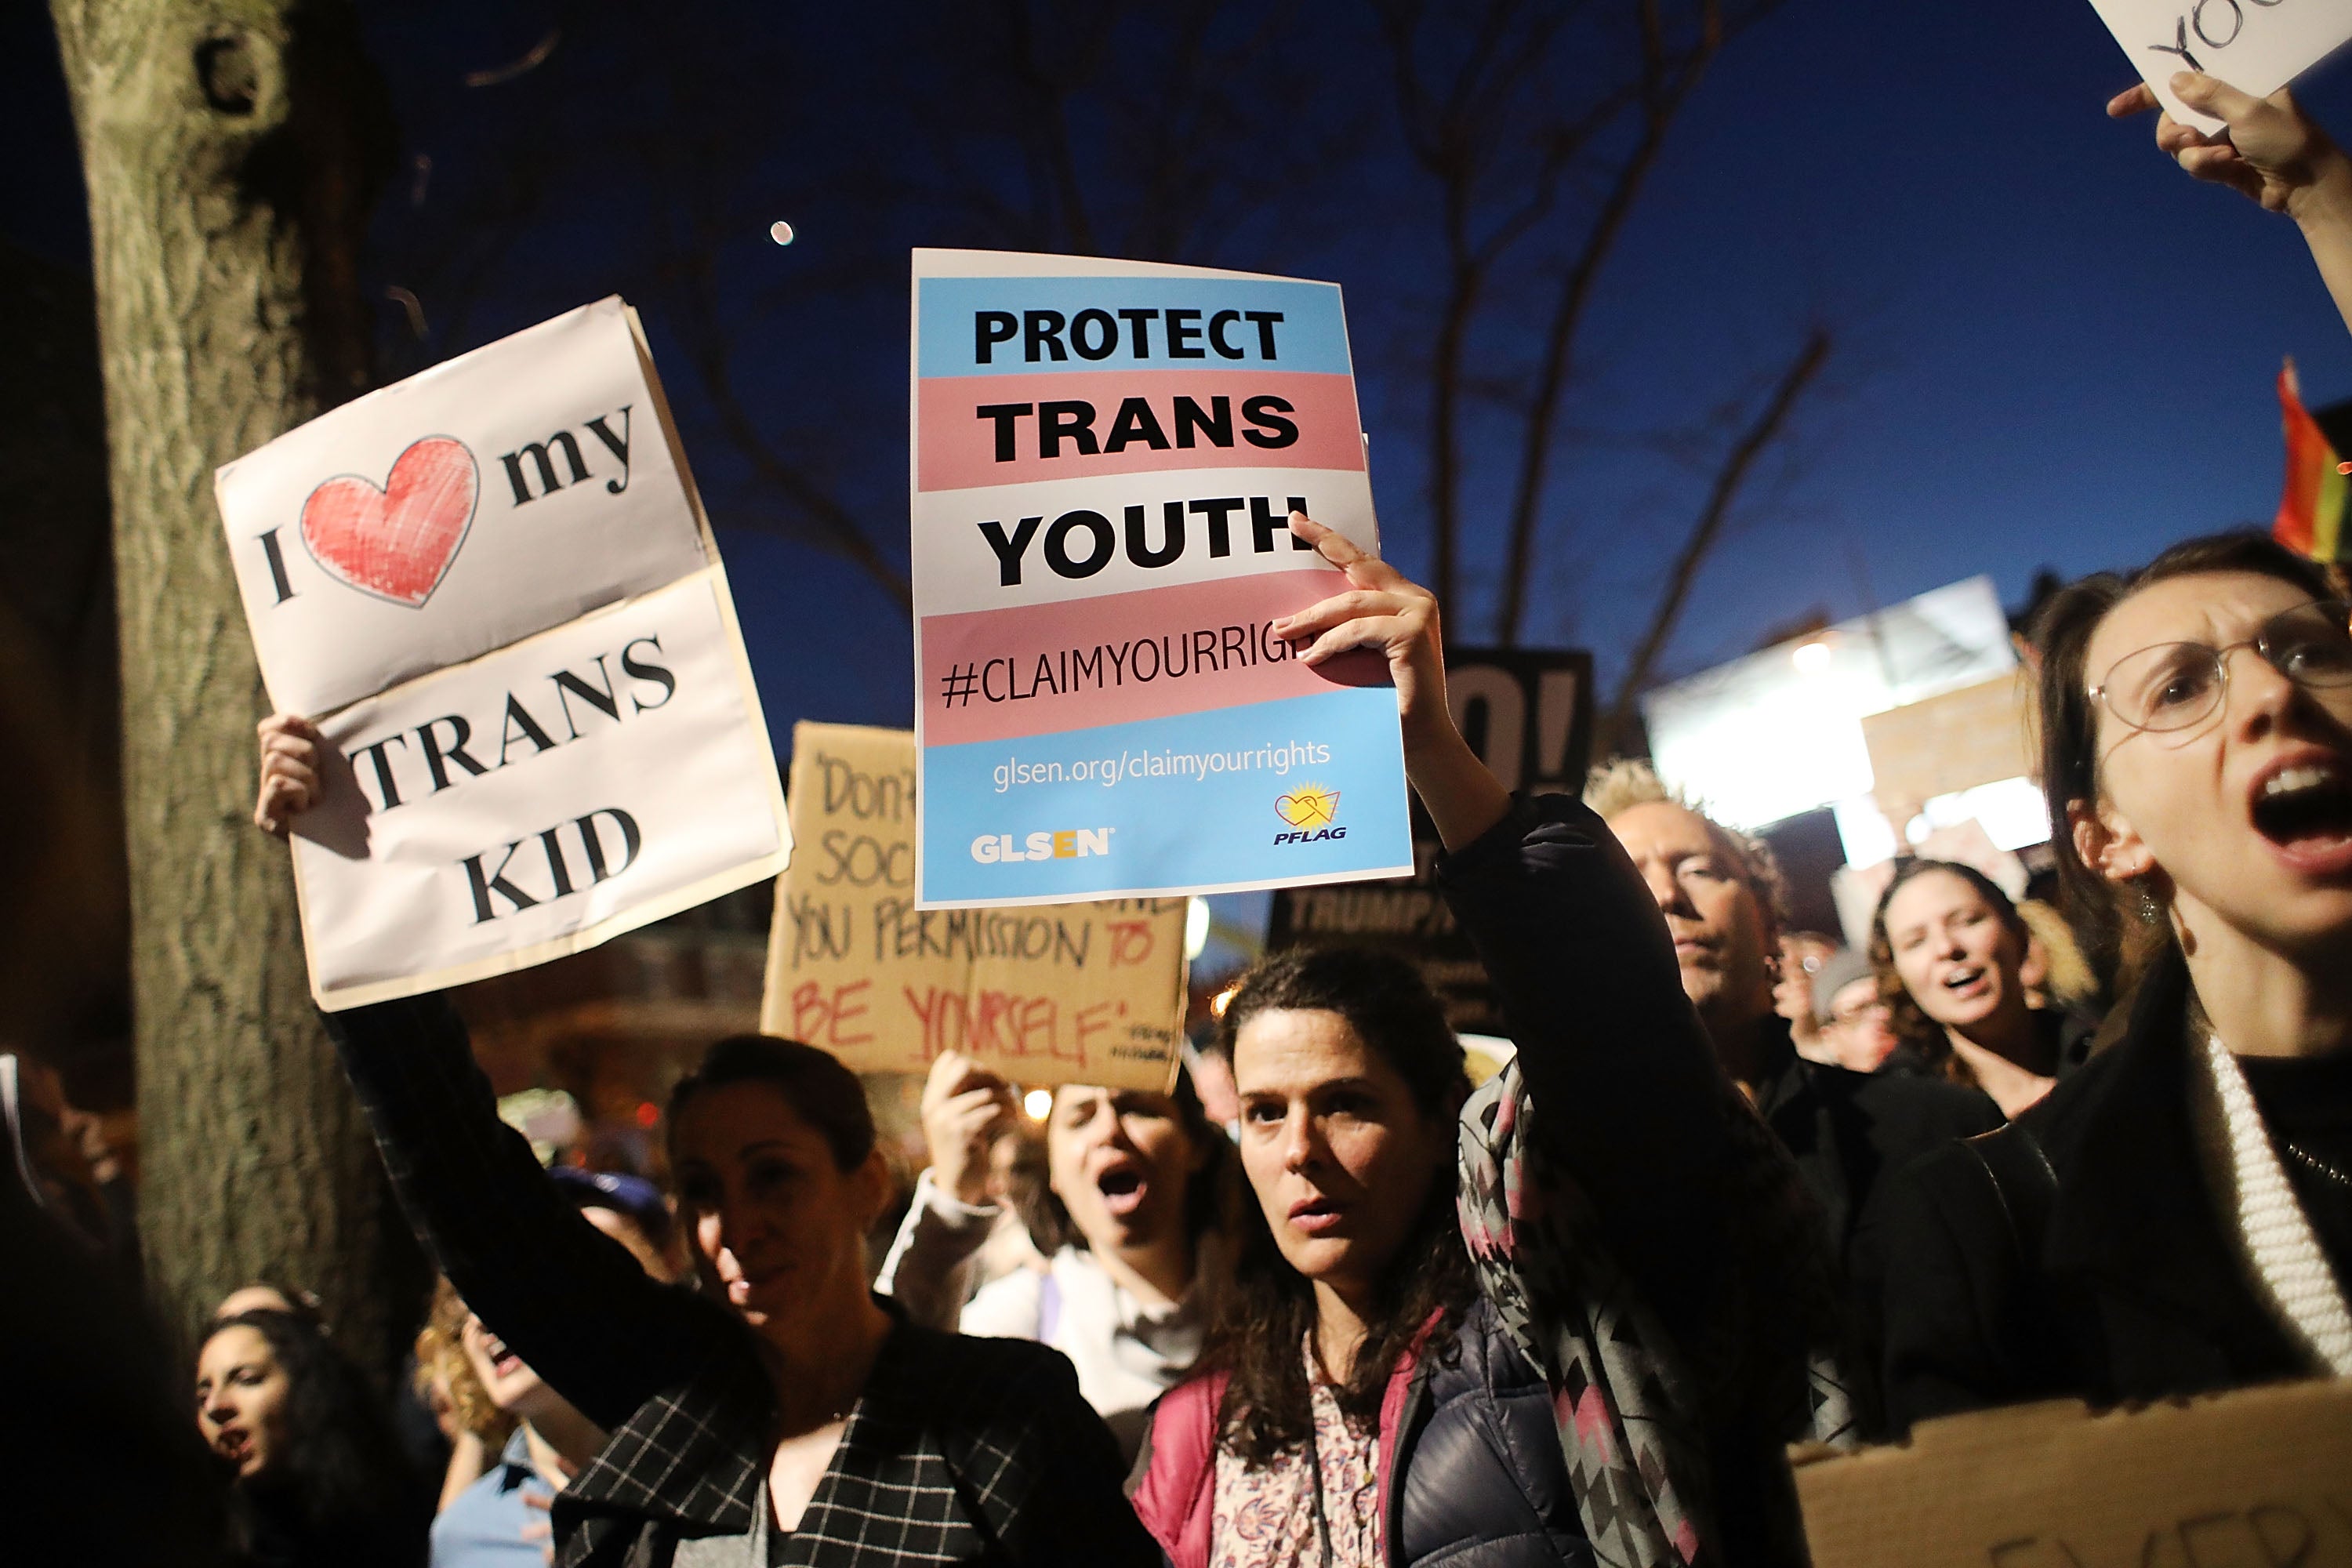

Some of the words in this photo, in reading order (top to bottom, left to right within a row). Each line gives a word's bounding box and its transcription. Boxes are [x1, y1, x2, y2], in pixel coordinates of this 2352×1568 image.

[2147, 0, 2284, 72] YO
[975, 308, 1284, 365] PROTECT
[976, 395, 1299, 463] TRANS
[255, 526, 301, 608] I
[498, 405, 634, 508] my
[978, 496, 1312, 587] YOUTH
[942, 619, 1315, 708] #CLAIMYOURRIG
[347, 632, 676, 814] TRANS
[993, 739, 1330, 793] glsen.org/claimyourrights
[456, 806, 641, 927] KID
[815, 829, 915, 888] SOC
[1274, 827, 1347, 845] PFLAG
[784, 891, 851, 971] YOU
[873, 895, 1091, 967] PERMISSION
[1106, 920, 1156, 967] TO
[791, 978, 874, 1045] BE
